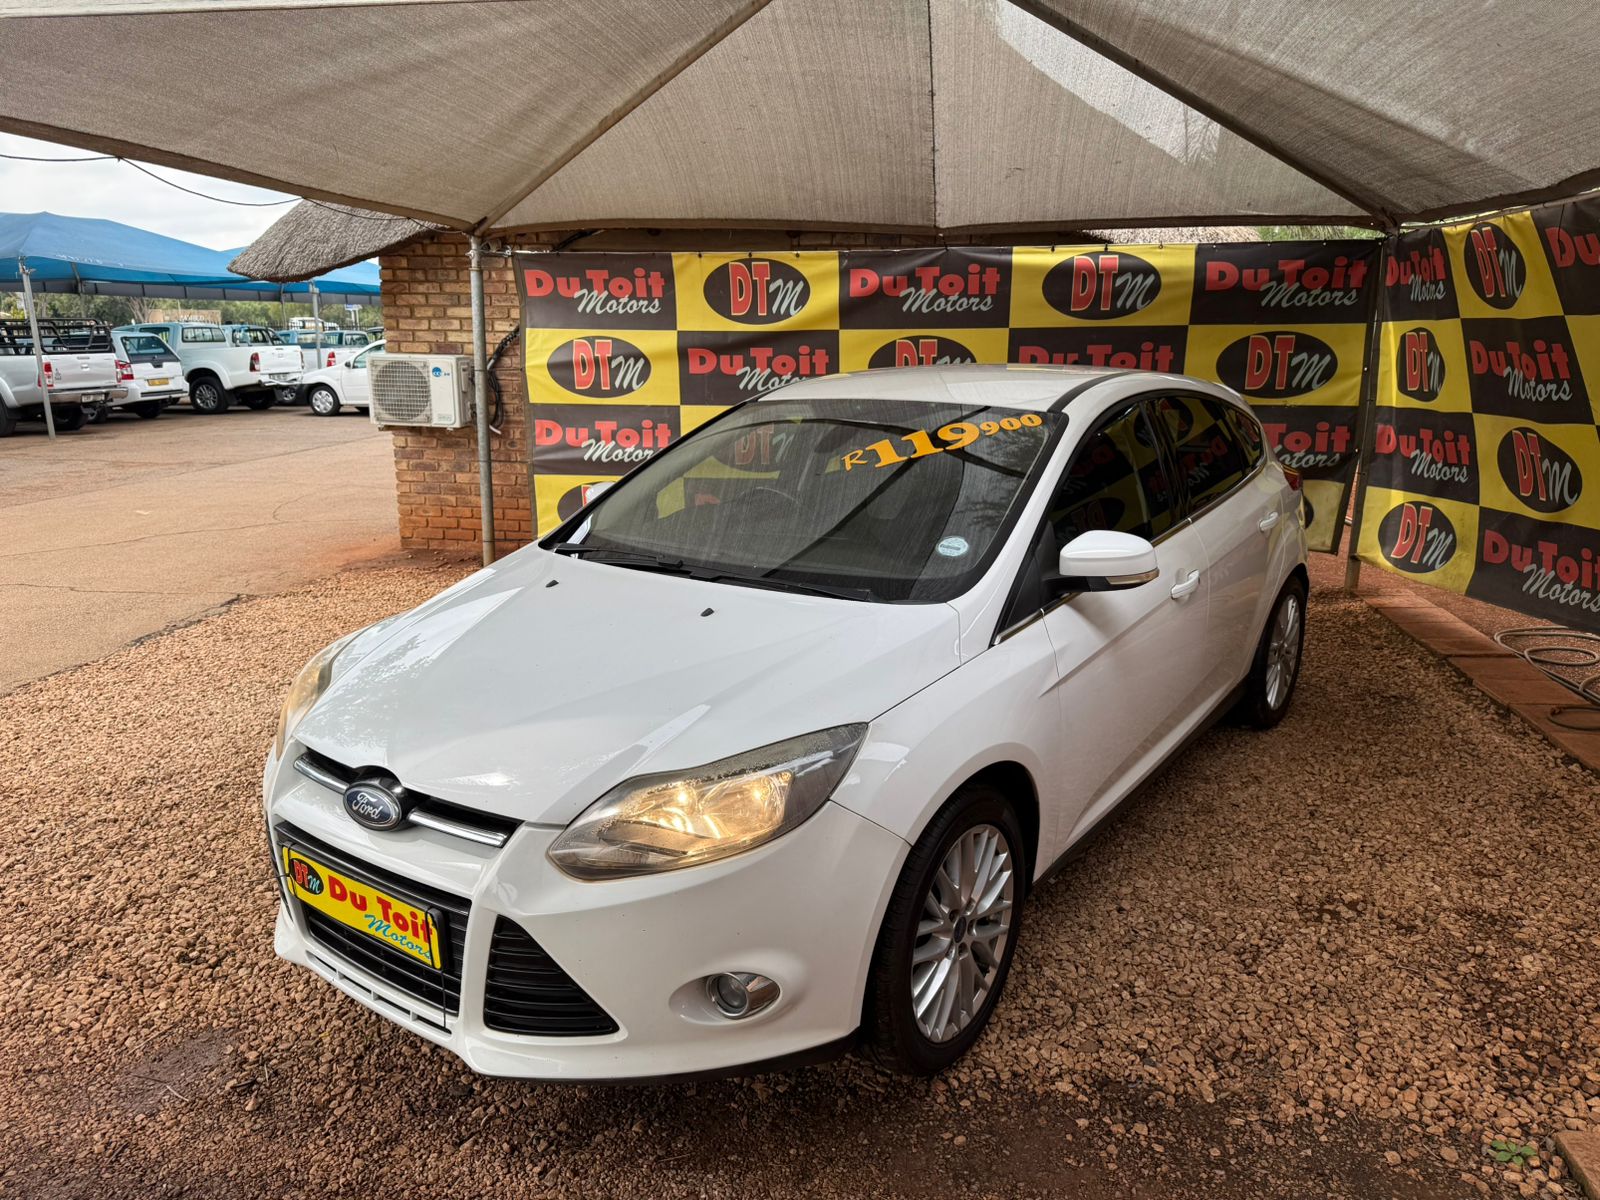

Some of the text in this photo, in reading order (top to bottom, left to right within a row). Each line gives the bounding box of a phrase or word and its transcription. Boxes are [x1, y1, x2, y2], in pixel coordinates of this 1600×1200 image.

[574, 289, 661, 315] Motors
[899, 286, 993, 314] Motors
[1259, 280, 1358, 308] Motors
[1504, 365, 1573, 402] Motors
[581, 438, 655, 463] Motor
[1273, 444, 1341, 469] otors
[1410, 449, 1469, 483] Motors
[351, 791, 384, 819] Ford
[328, 874, 434, 944] Du Toit
[364, 914, 432, 961] Motors
